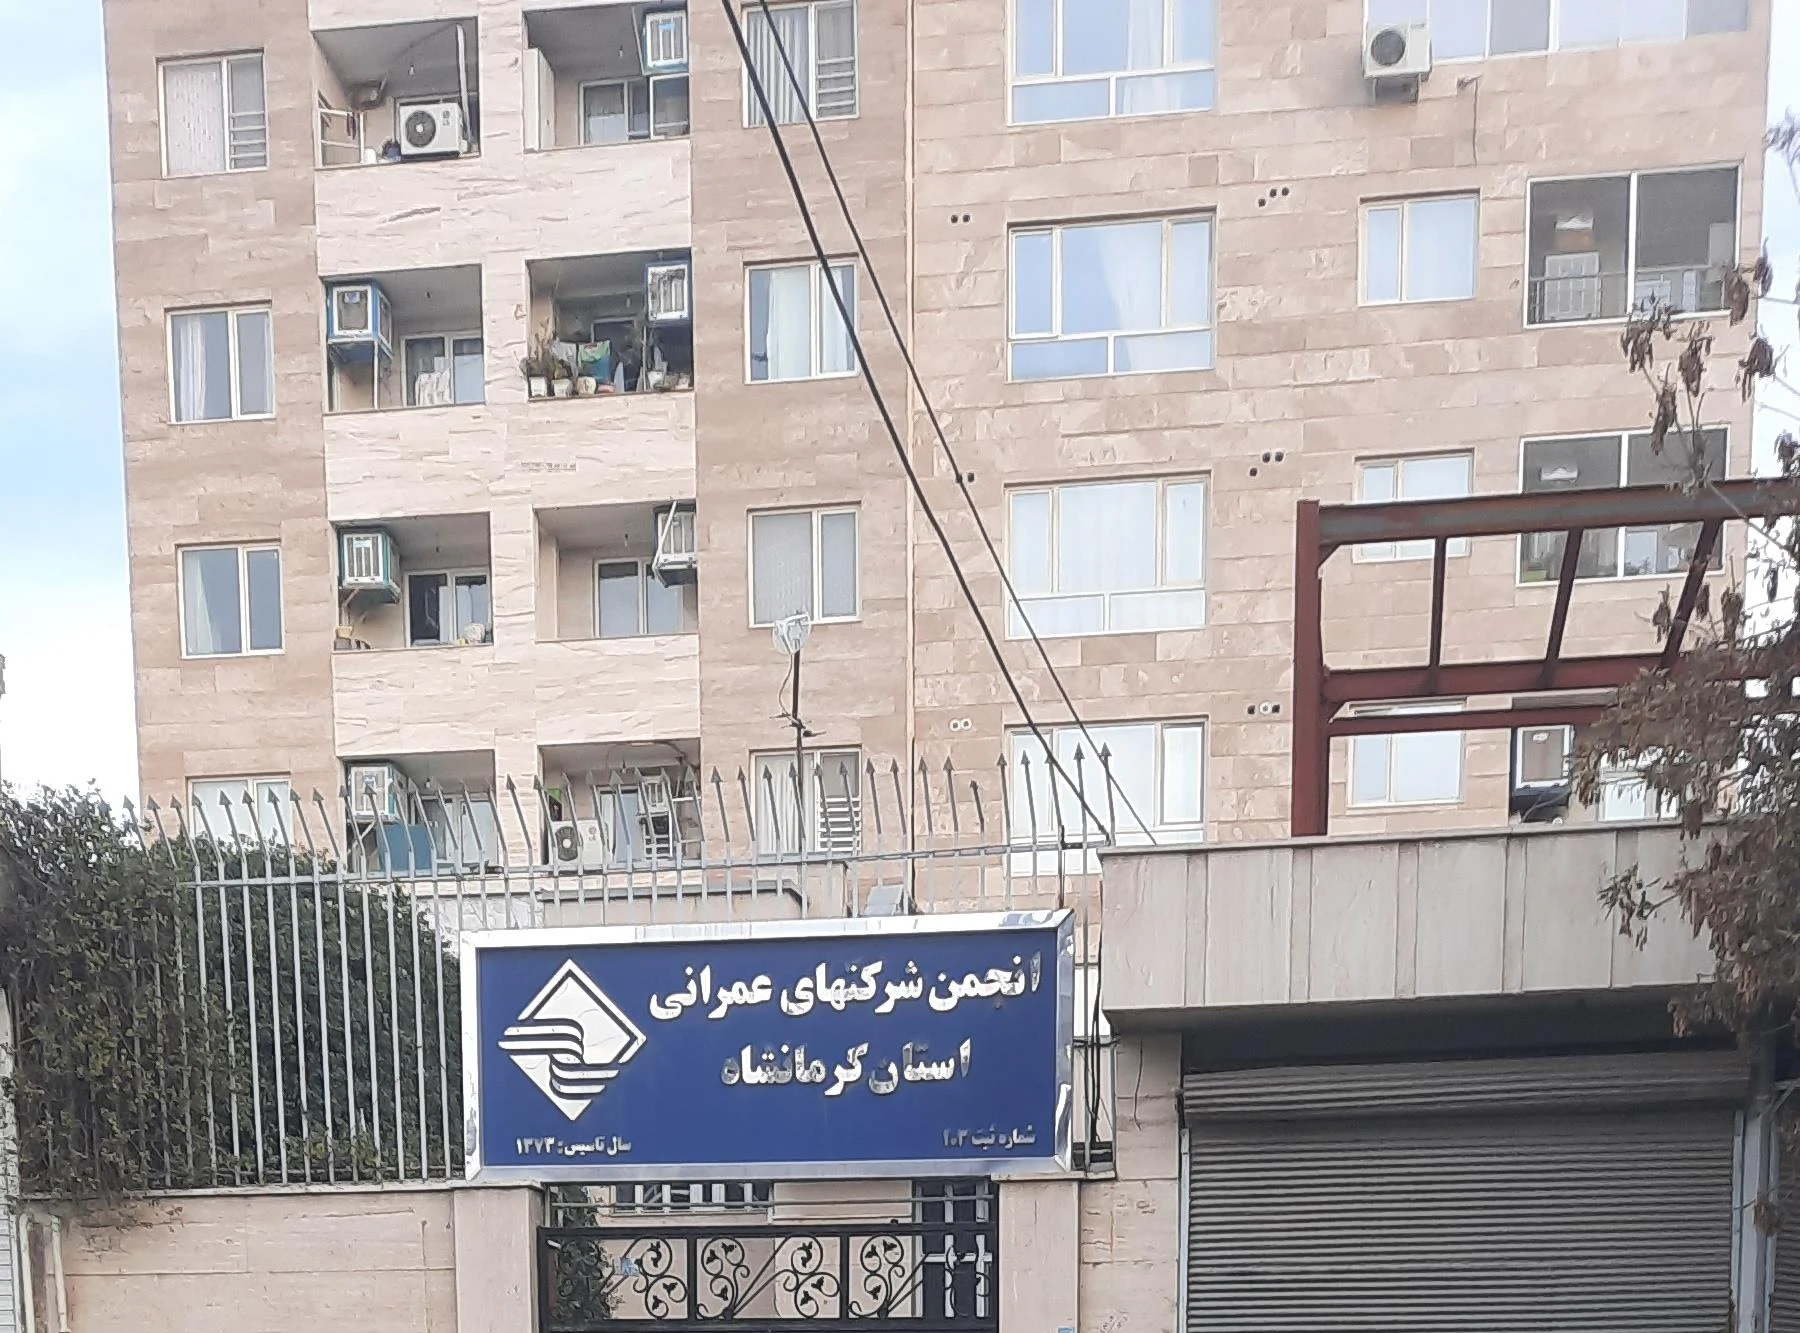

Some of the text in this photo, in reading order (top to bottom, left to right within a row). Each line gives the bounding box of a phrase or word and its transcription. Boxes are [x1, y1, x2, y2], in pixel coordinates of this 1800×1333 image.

[649, 964, 772, 1020] عمرانی
[928, 950, 1041, 1012] انجمن
[868, 1038, 971, 1094] استان
[516, 1136, 555, 1155] ۱۳۷۳
[606, 1136, 632, 1156] سال
[971, 1125, 996, 1151] ثبت
[998, 1124, 1036, 1149] شماره
